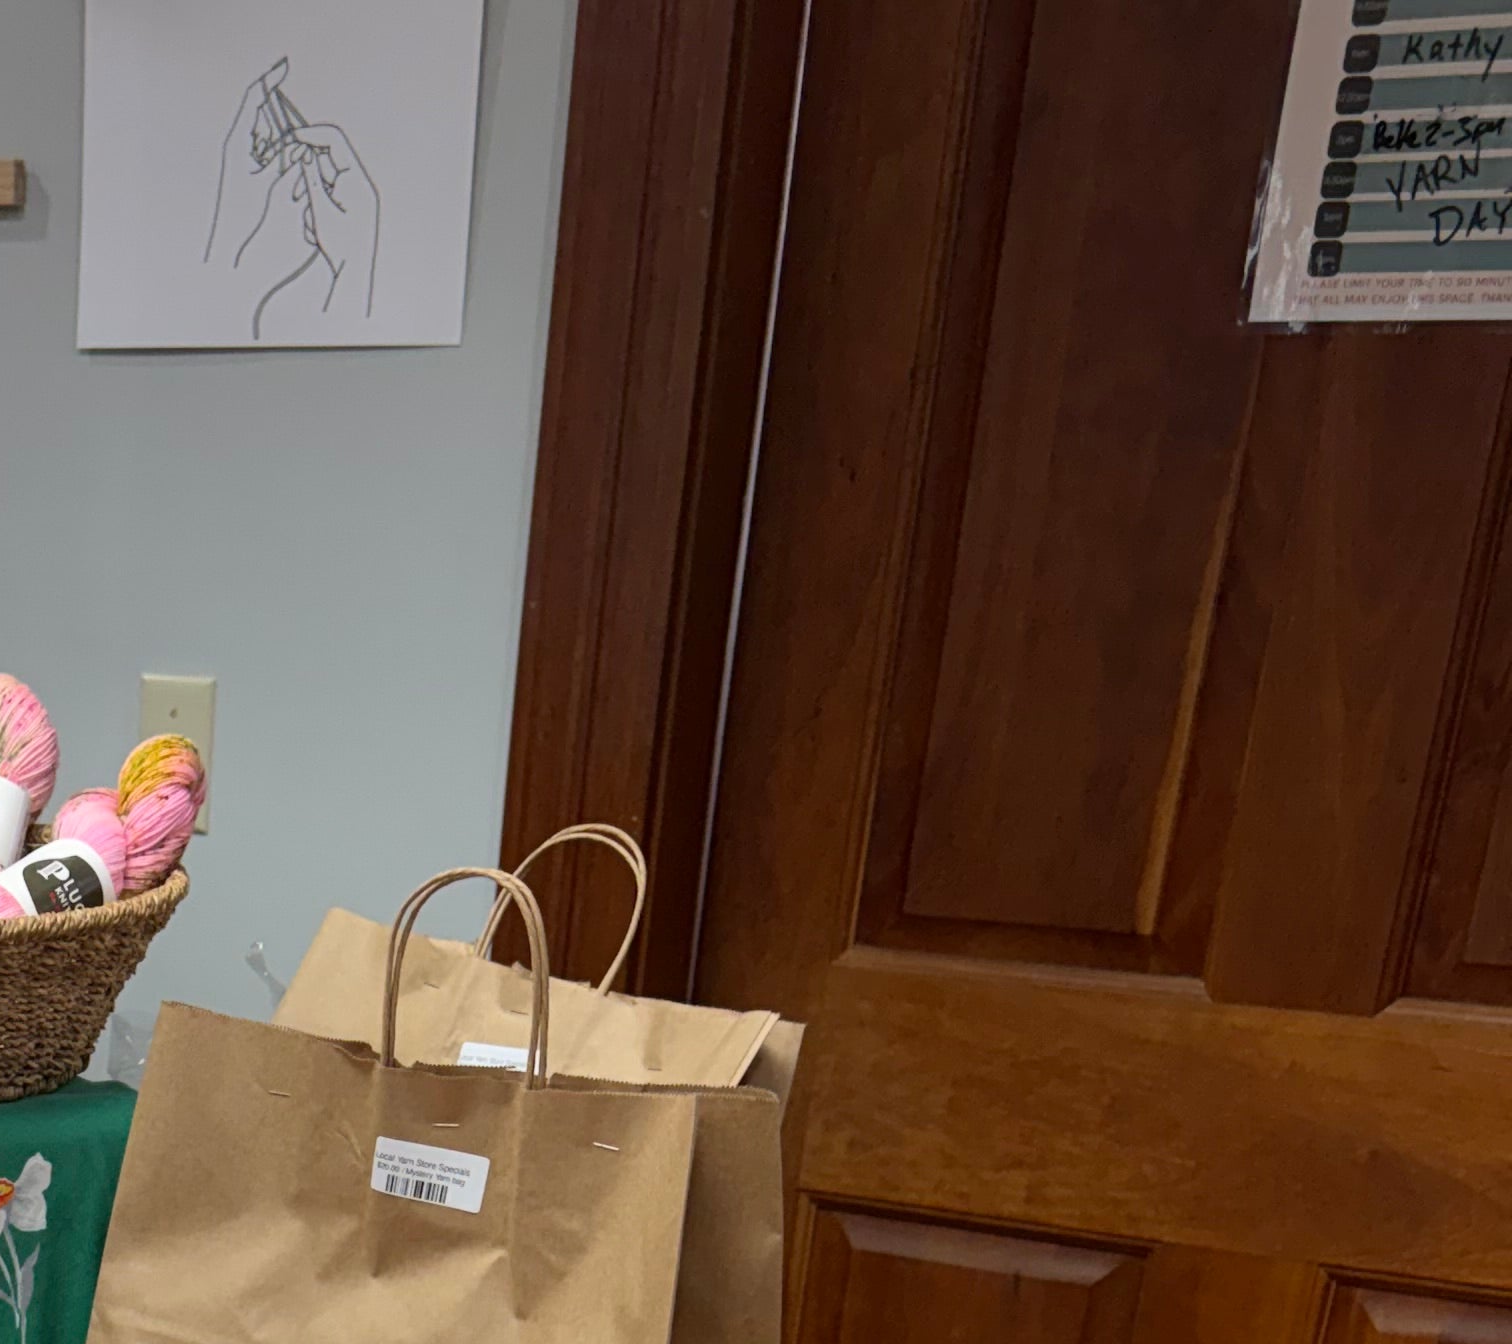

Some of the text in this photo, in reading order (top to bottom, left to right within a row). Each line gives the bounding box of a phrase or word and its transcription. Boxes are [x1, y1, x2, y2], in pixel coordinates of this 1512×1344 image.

[1402, 27, 1504, 82] Kathy
[1385, 140, 1480, 212] YARN
[1428, 197, 1512, 246] DAY
[1375, 277, 1406, 289] YOUR
[1439, 276, 1454, 288] TO
[376, 1152, 395, 1163] Local
[398, 1156, 414, 1166] Yarn
[417, 1159, 437, 1170] Store
